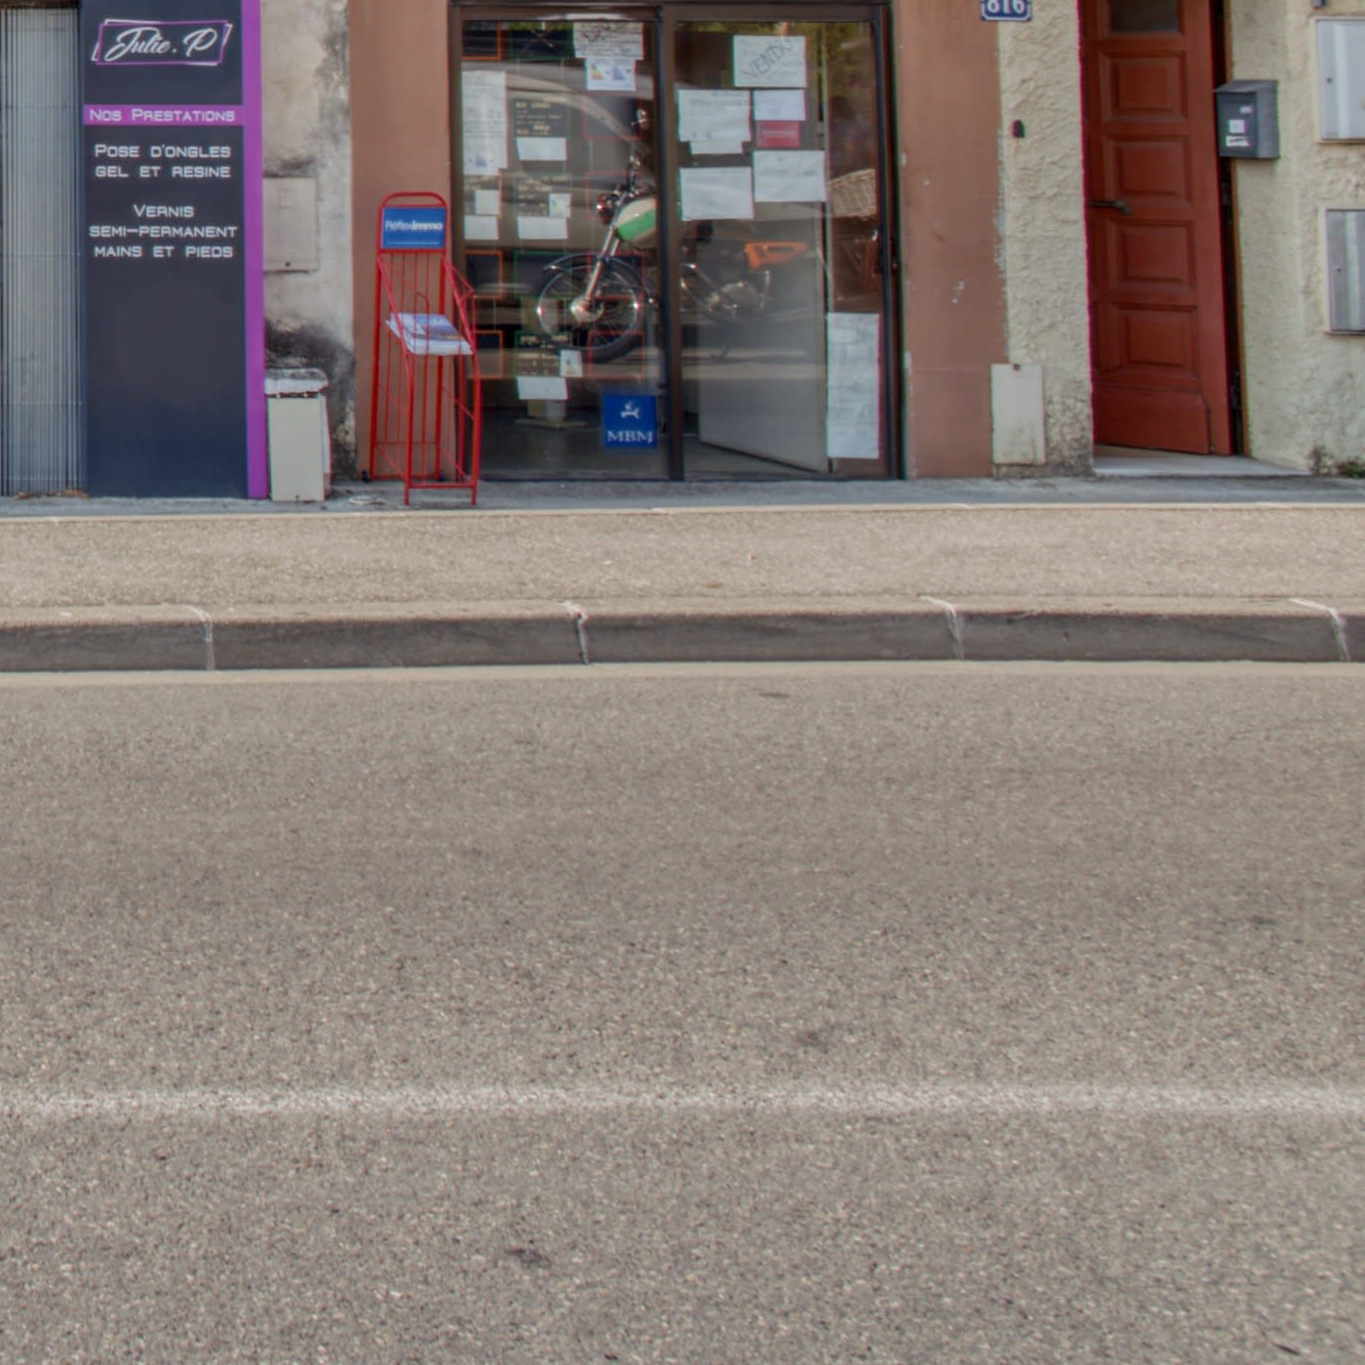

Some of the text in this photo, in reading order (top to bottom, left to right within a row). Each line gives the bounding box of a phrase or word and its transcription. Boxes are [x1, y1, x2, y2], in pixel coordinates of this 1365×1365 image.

[183, 27, 218, 57] P
[89, 108, 236, 122] NOS PRESTATIONS
[94, 144, 232, 158] POSE D'ONGLES
[95, 166, 232, 178] GEL ET RESINE
[133, 204, 195, 218] VERNIS
[89, 225, 238, 238] SEMI-PERMANENT
[94, 246, 234, 258] MAINS ET PIEDS
